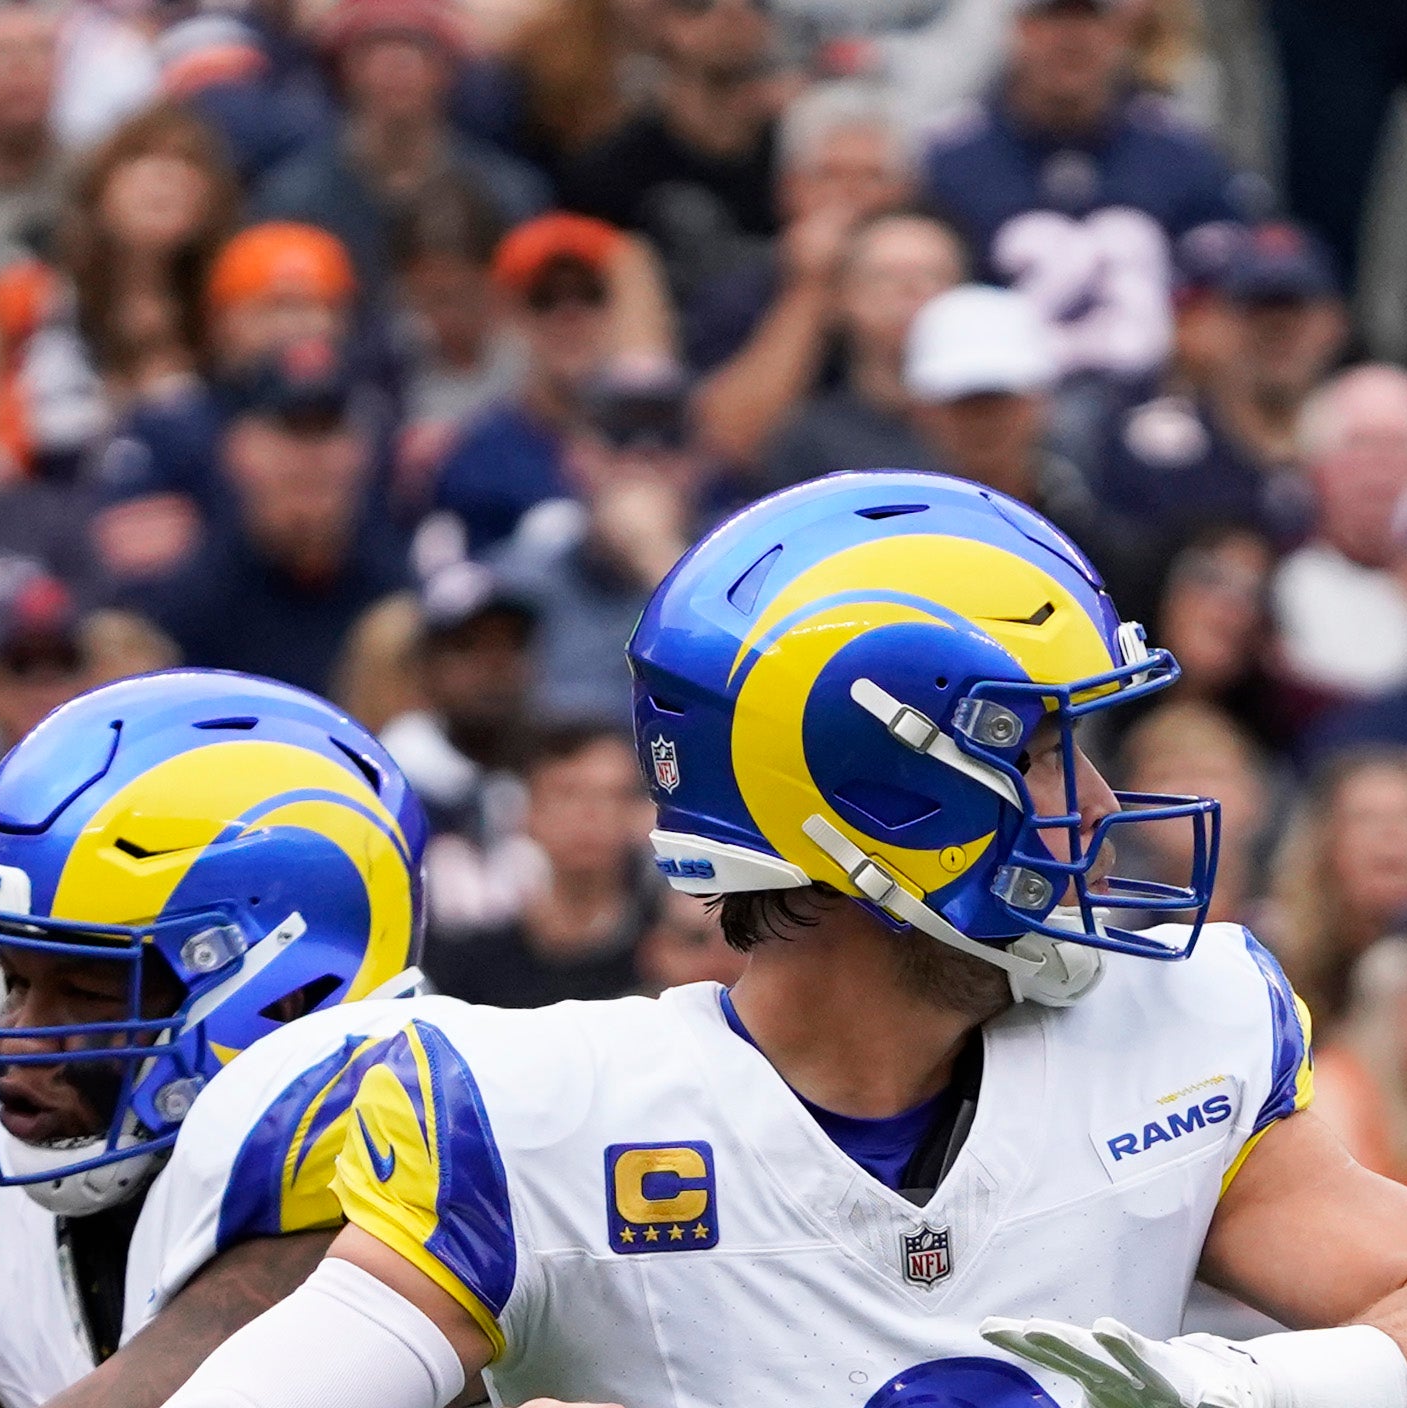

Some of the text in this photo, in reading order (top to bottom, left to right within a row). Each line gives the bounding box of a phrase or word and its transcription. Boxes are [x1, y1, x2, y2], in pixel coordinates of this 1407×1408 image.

[1106, 1094, 1232, 1162] RAMS
[613, 1146, 710, 1226] C
[910, 1251, 947, 1279] NFL
